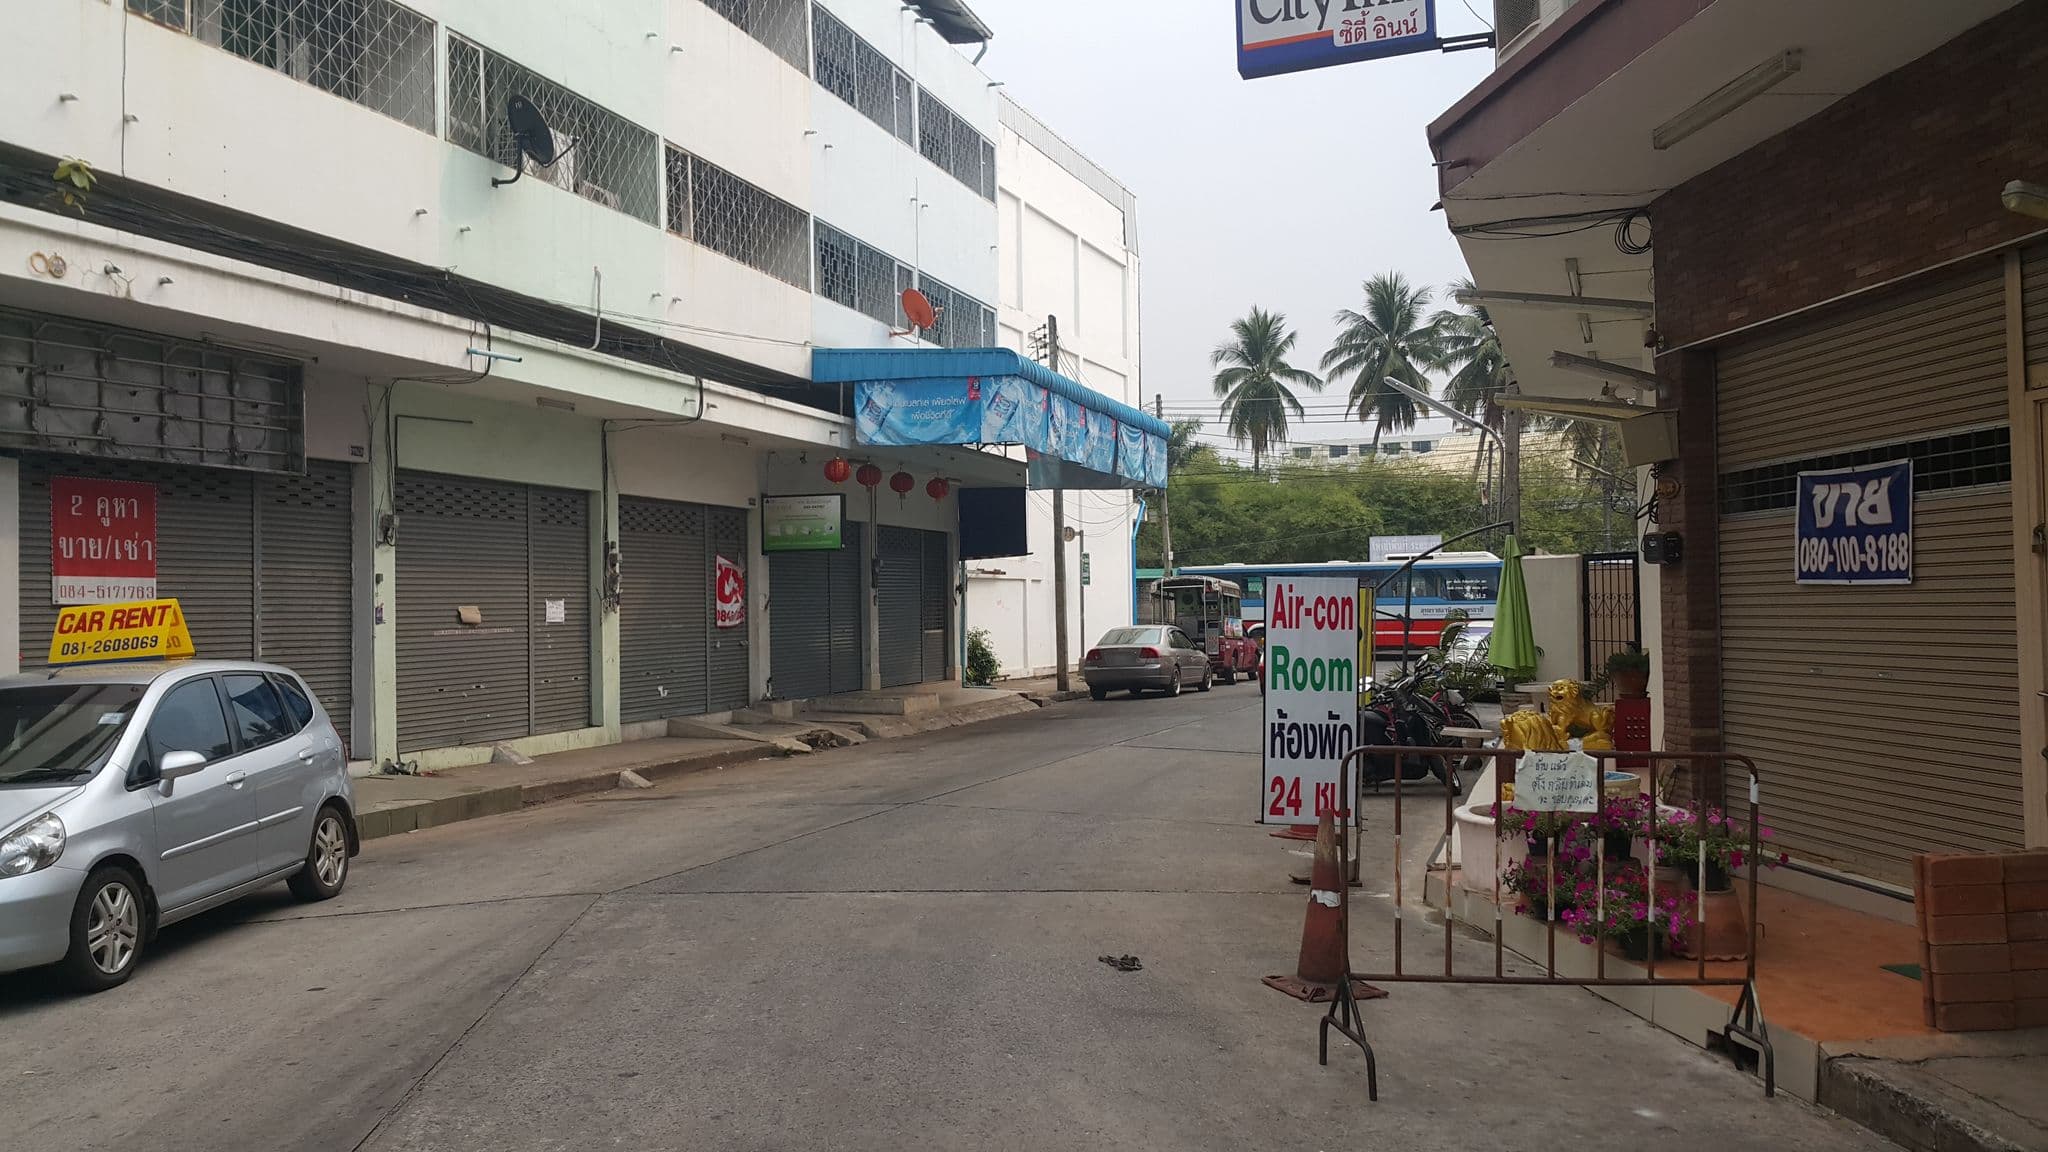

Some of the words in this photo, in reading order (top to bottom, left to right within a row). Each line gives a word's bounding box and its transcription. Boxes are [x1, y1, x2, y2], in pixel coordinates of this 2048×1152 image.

[1339, 11, 1370, 44] ซิตี้
[1372, 8, 1418, 39] อินน์
[71, 495, 82, 516] 2
[96, 496, 138, 527] คูหา
[1812, 476, 1893, 529] ขาย
[59, 532, 153, 561] ขาย/เช่า
[1800, 532, 1908, 573] 080-100-8188
[57, 610, 106, 634] CAR
[109, 605, 172, 631] RENT
[1271, 584, 1354, 631] Air-con
[61, 635, 159, 656] 081-2608069
[1271, 645, 1353, 692] Room
[1270, 708, 1353, 761] ห้องพัก
[1269, 775, 1302, 817] 24
